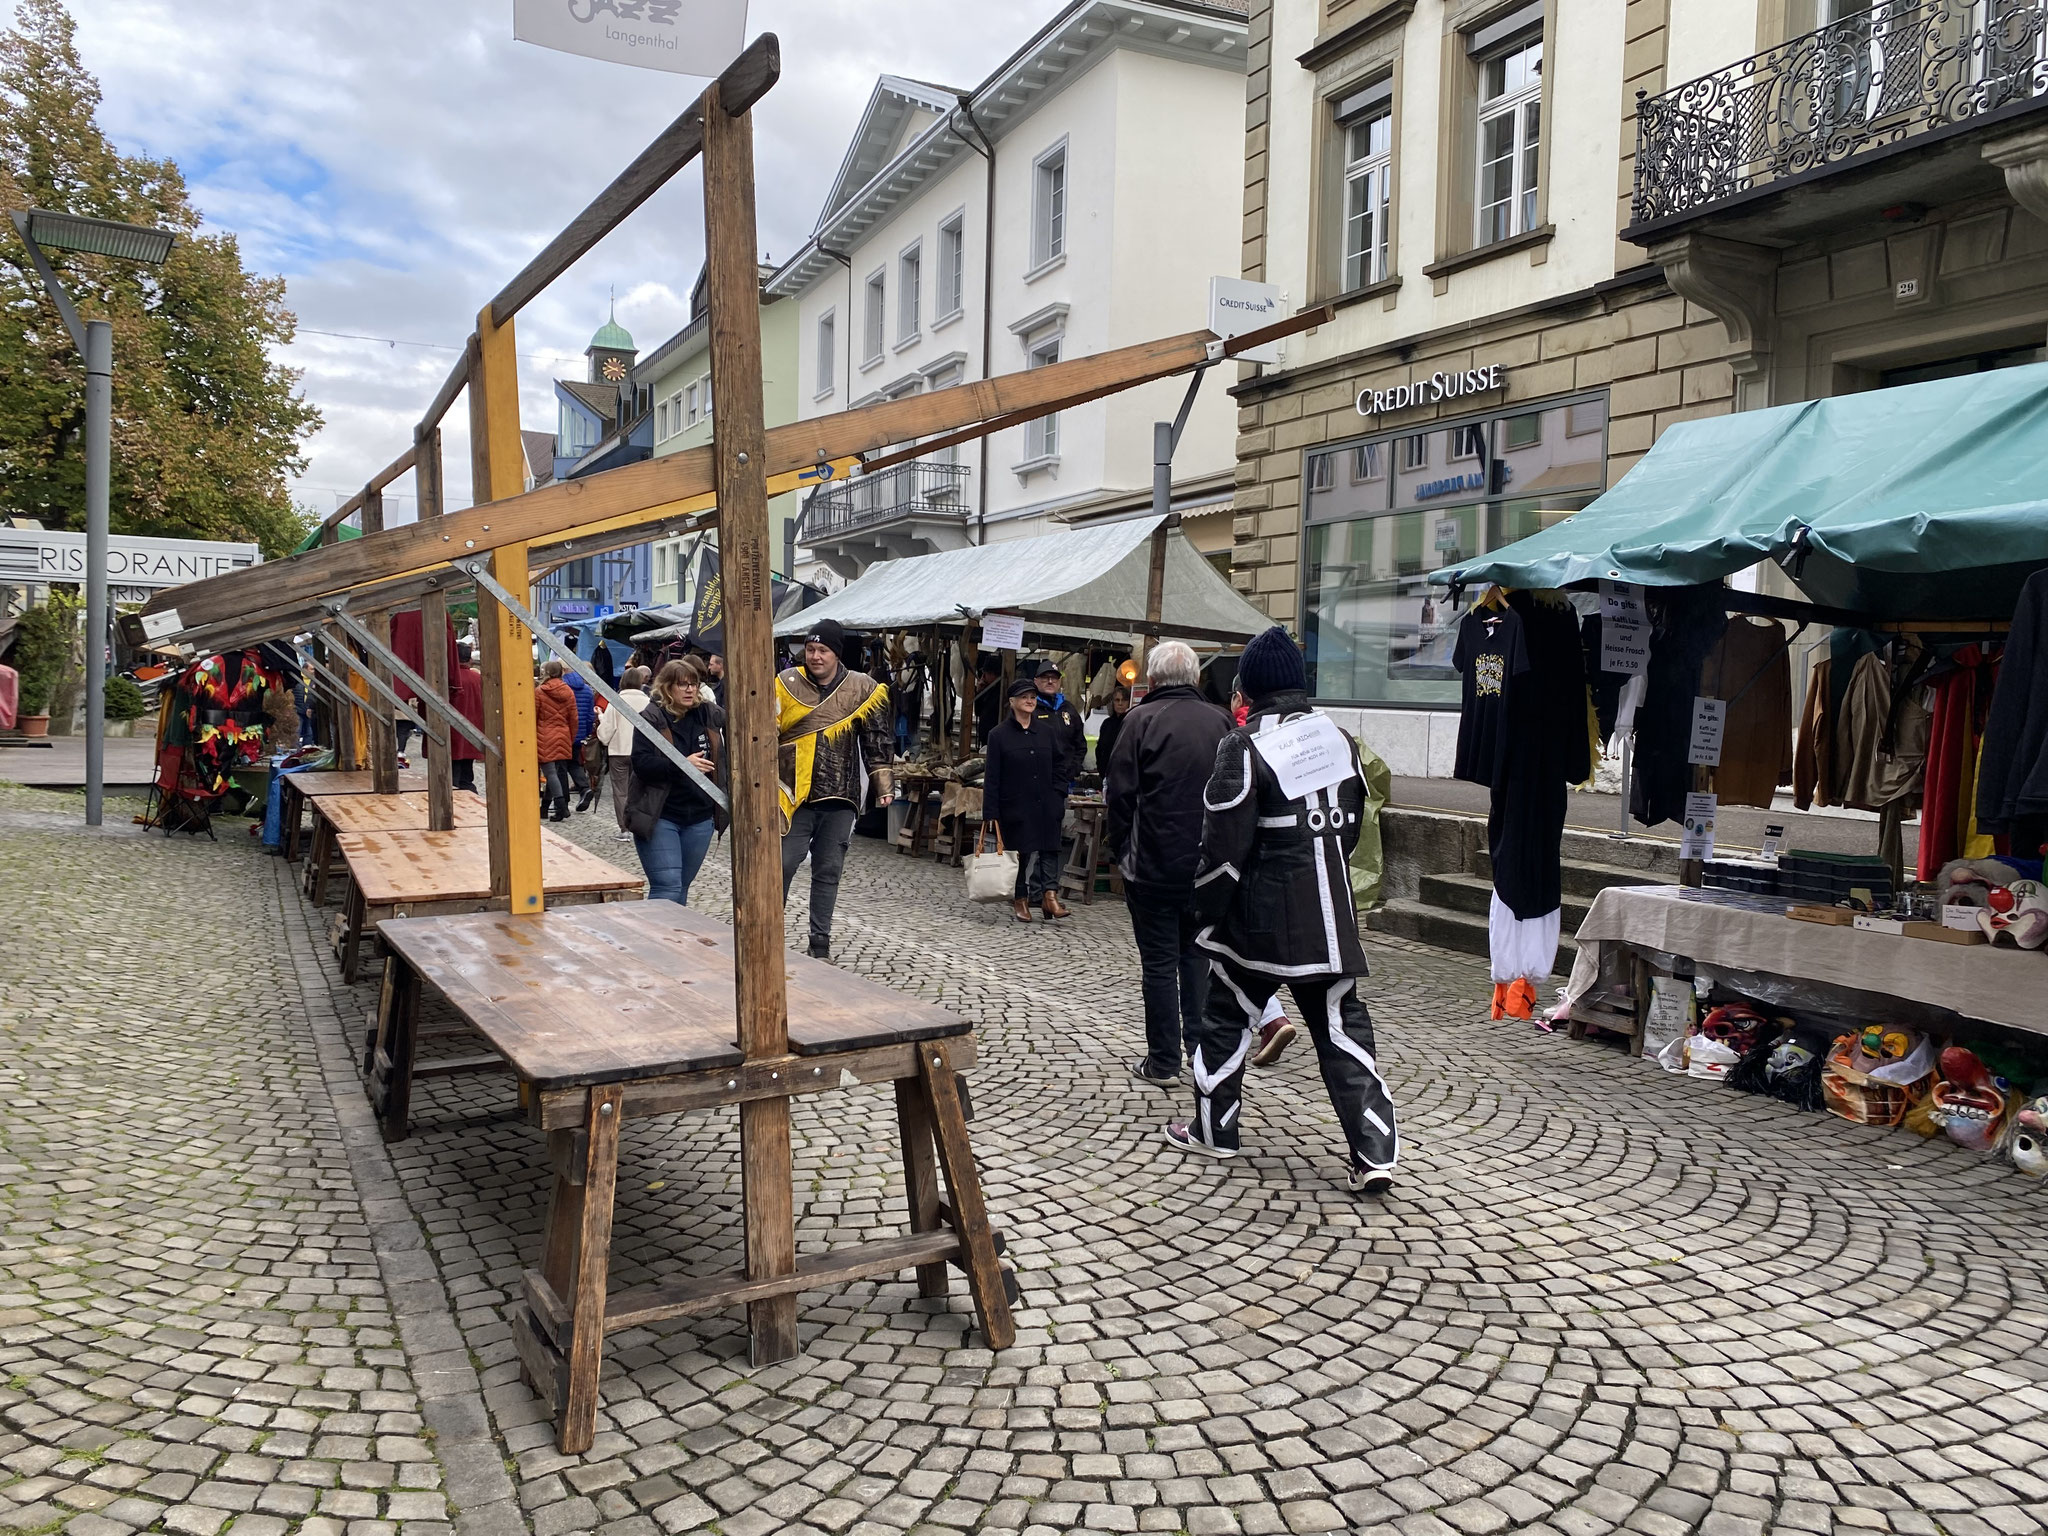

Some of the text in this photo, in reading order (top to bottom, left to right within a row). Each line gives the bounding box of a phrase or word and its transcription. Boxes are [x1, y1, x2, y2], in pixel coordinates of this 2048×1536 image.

[606, 25, 678, 50] Langenthal
[1900, 282, 1914, 294] 29
[1219, 297, 1267, 312] CREDIT SUISSE
[1356, 363, 1502, 416] CREDIT SUISSE
[41, 547, 230, 578] RISORANTE
[1608, 597, 1637, 609] Do gits:
[1605, 644, 1645, 655] Heisse Frosch
[1609, 658, 1639, 668] je Fr. 5.50
